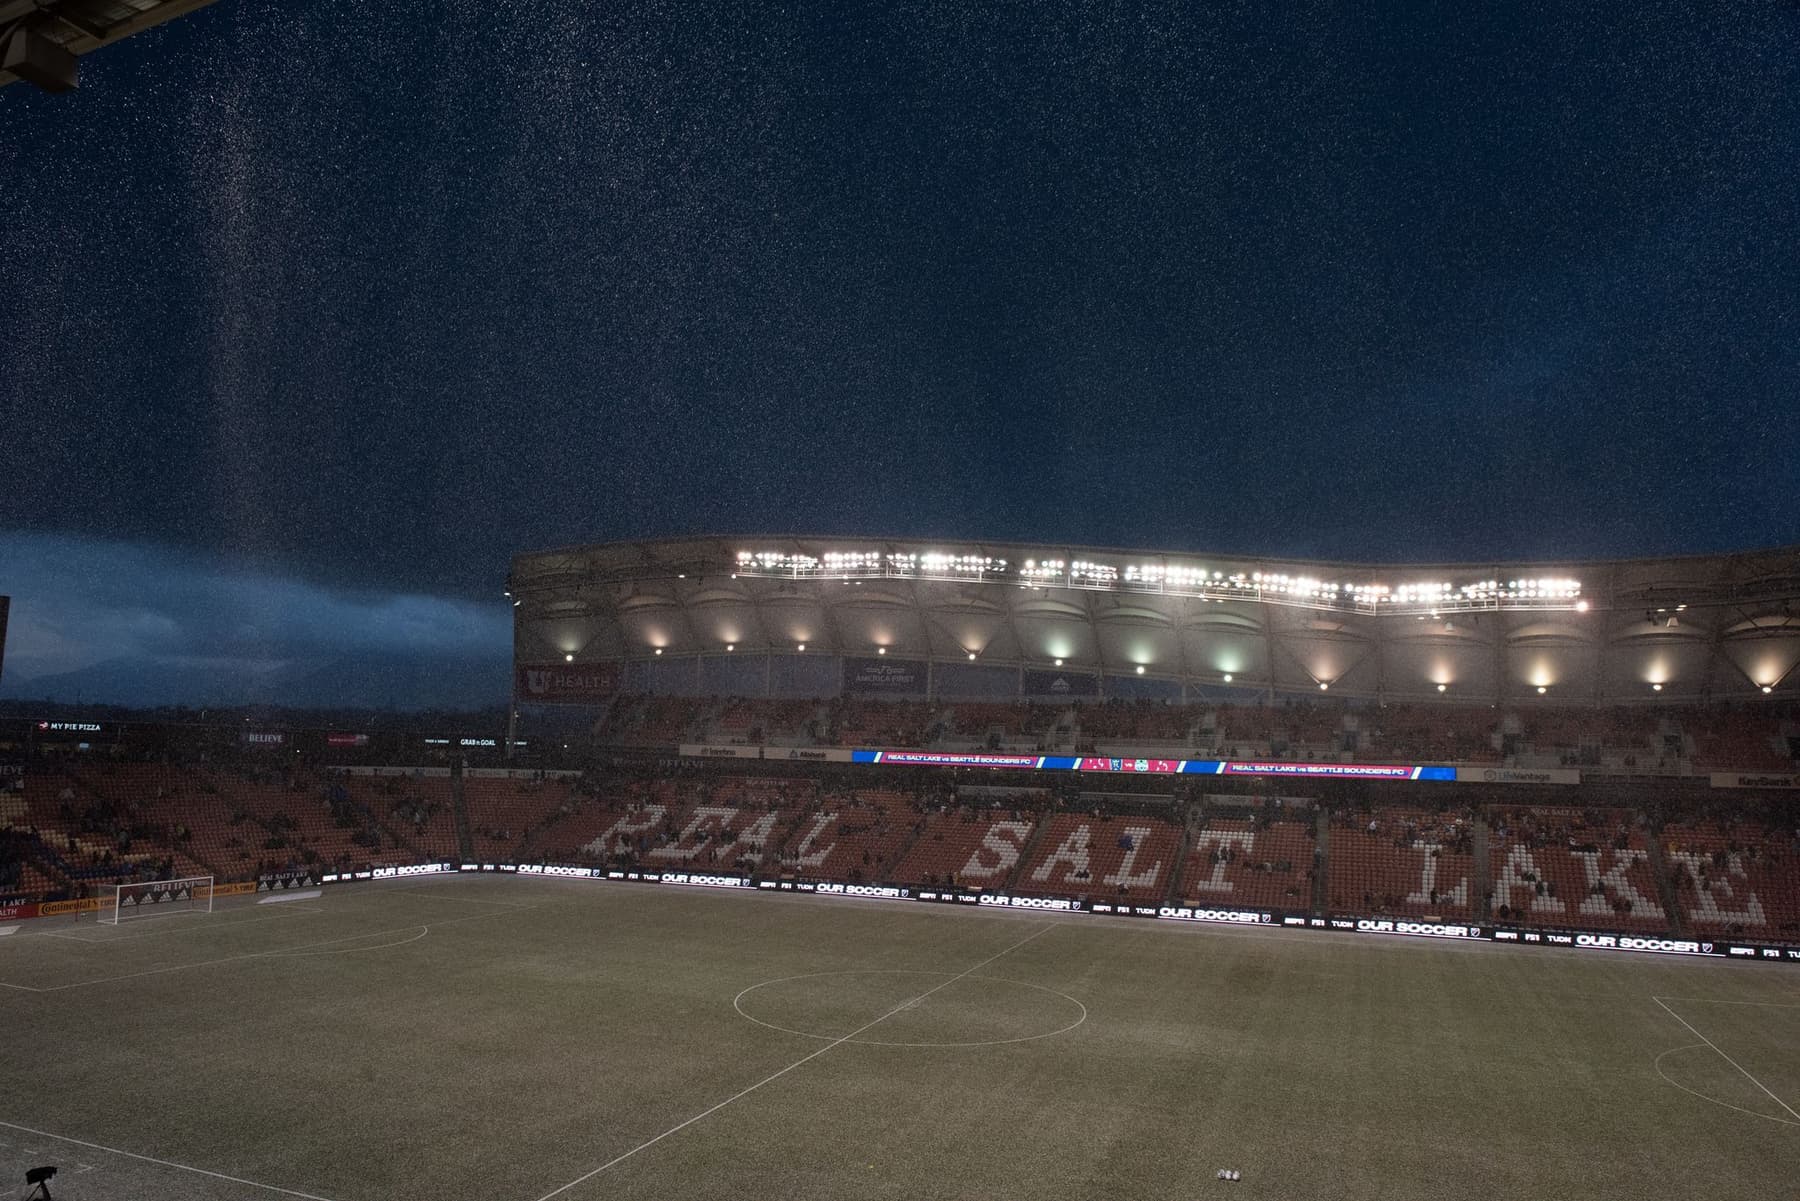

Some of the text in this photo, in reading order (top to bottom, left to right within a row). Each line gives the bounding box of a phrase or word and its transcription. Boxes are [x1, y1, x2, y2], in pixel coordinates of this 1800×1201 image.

[249, 734, 283, 742] BELIEVE
[373, 867, 396, 877] OUR
[397, 863, 442, 875] SOCCER
[518, 864, 542, 873] OUR
[543, 865, 592, 877] SOCCER
[581, 804, 1766, 925] REAL SALT LAKE
[661, 873, 687, 883] OUR
[689, 875, 741, 887] SOCCER
[817, 883, 844, 892] OUR
[845, 884, 900, 897] SOCCER
[41, 899, 91, 914] Continental
[979, 894, 1009, 905] OUR
[1011, 896, 1071, 910] SOCCER
[1159, 907, 1192, 918] OUR
[1194, 909, 1260, 923] SOCCER
[1357, 920, 1394, 932] OUR
[1396, 922, 1468, 937] SOCCER
[1576, 935, 1616, 947] OUR
[1619, 937, 1700, 953] SOCCER
